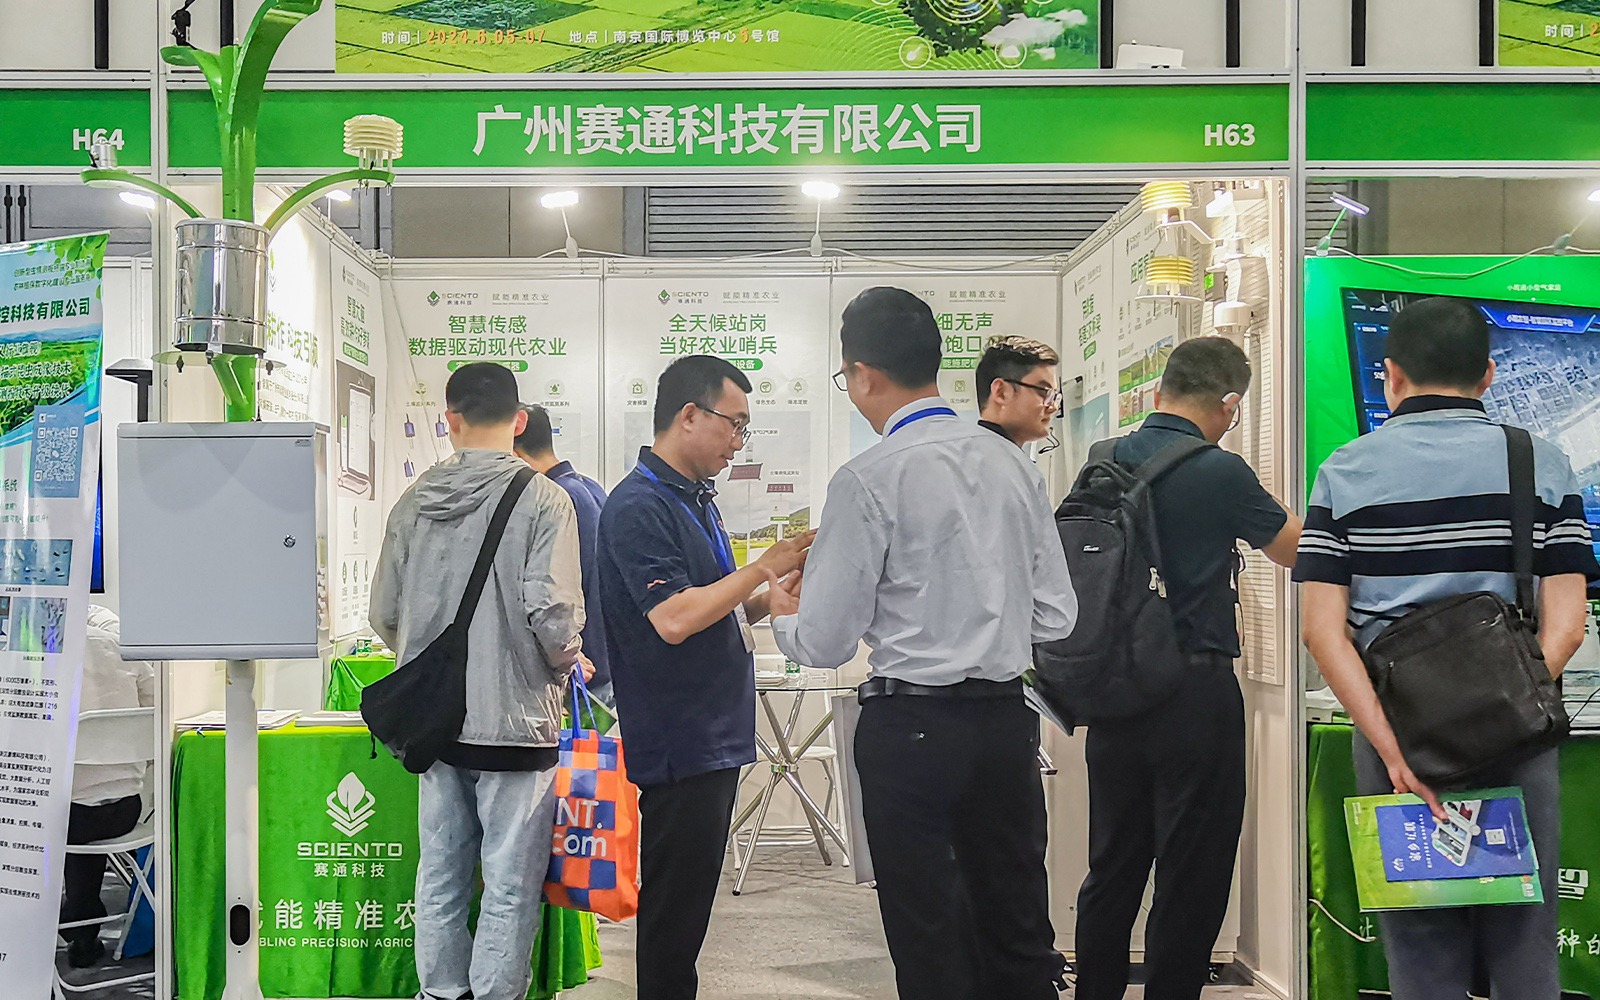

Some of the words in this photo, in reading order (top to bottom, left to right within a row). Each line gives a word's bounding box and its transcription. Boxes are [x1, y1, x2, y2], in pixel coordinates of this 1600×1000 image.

[381, 31, 411, 45] 时间
[569, 31, 598, 43] 地点
[1545, 24, 1574, 37] 时间
[473, 103, 982, 156] 广州赛通科技有限公司
[1204, 123, 1256, 147] H63
[448, 315, 527, 334] 智慧传感
[668, 313, 767, 333] 全天候站岗
[936, 312, 994, 331] 细无声
[408, 337, 567, 356] 数据驱动现代农业
[659, 335, 778, 355] 当好农业哨兵
[297, 842, 403, 857] SCIENTO
[314, 862, 385, 878] 赛通科技
[258, 898, 415, 931] 能精准农
[301, 937, 369, 948] PRECISION
[374, 937, 415, 948] AGRIC
